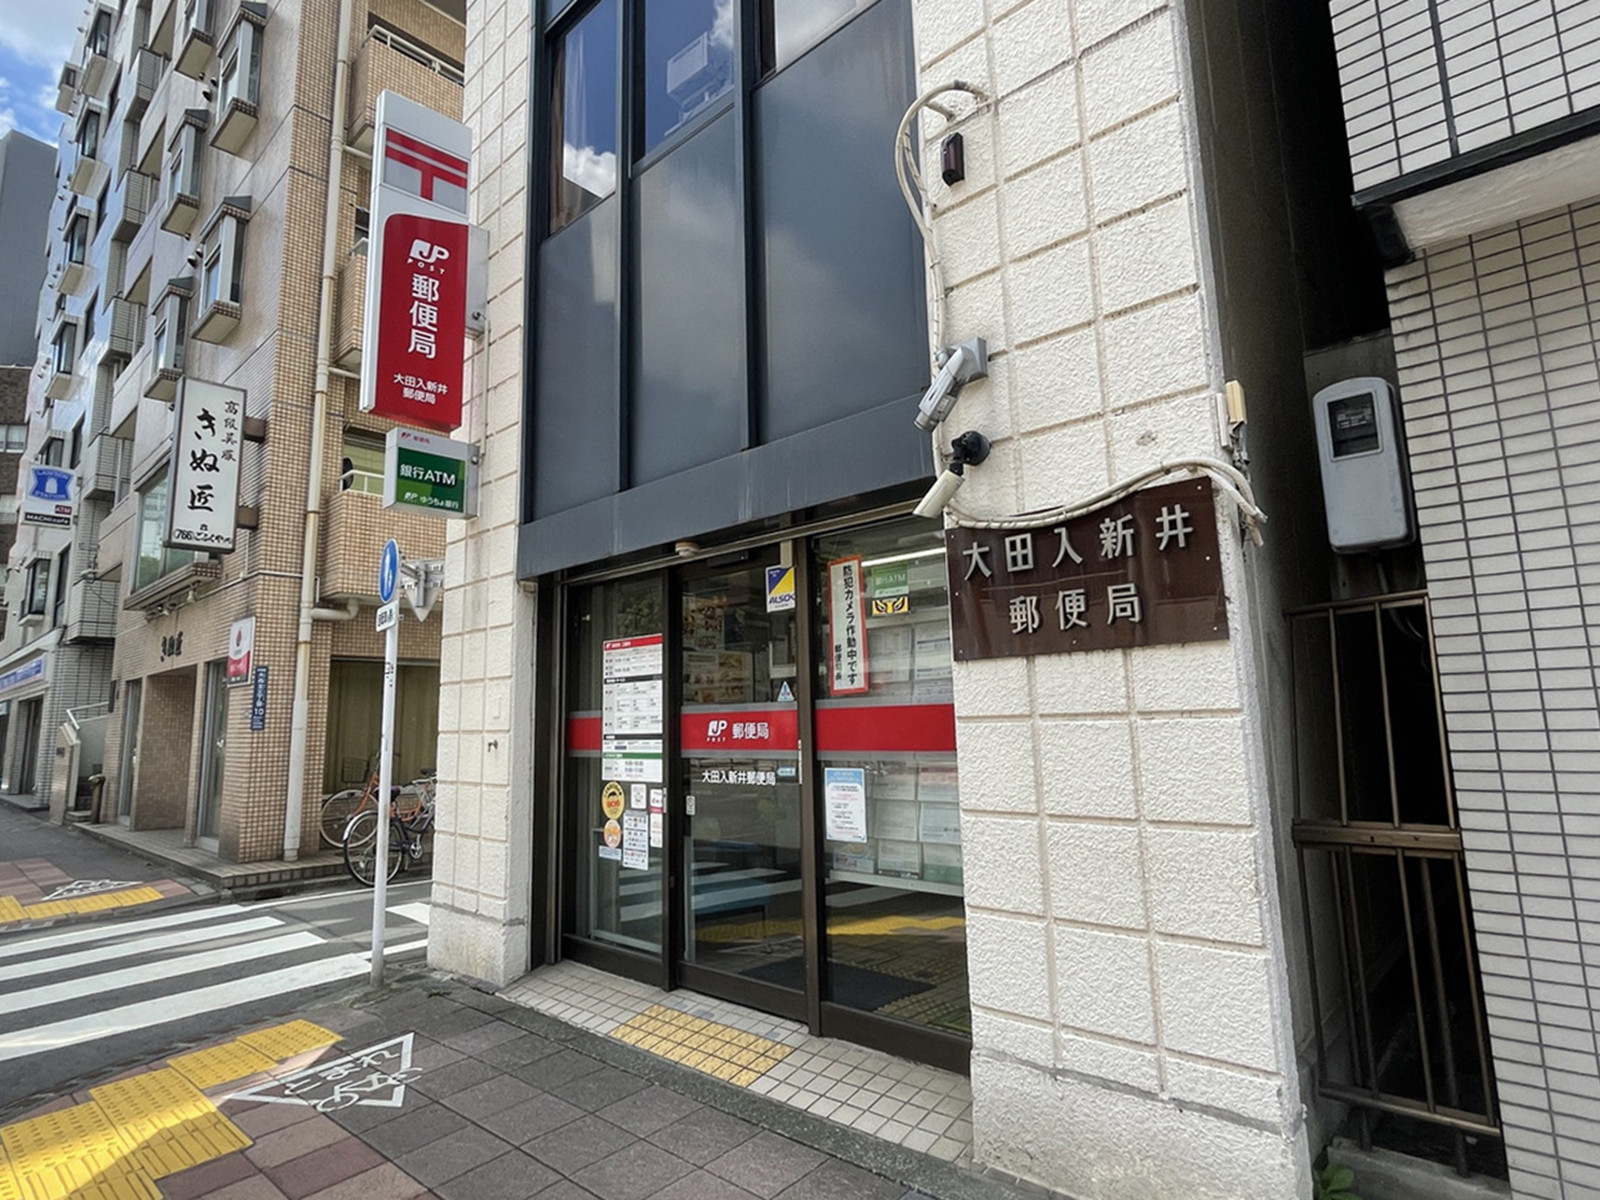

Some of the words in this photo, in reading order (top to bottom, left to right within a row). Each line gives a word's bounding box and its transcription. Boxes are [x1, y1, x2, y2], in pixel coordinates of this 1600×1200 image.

[408, 273, 440, 359] 郵便局
[393, 373, 449, 395] 大田入新井
[402, 388, 437, 405] 郵便局
[187, 407, 221, 512] きぬ匠
[400, 463, 456, 486] 銀行ATM
[420, 496, 460, 510] ゆうちょ銀行
[962, 503, 1194, 581] 大田入新井
[1008, 582, 1143, 635] 郵便局
[842, 564, 858, 685] 防犯カメラ作動中です
[732, 722, 770, 740] 郵便局
[701, 769, 777, 786] 大田入新井郵便局
